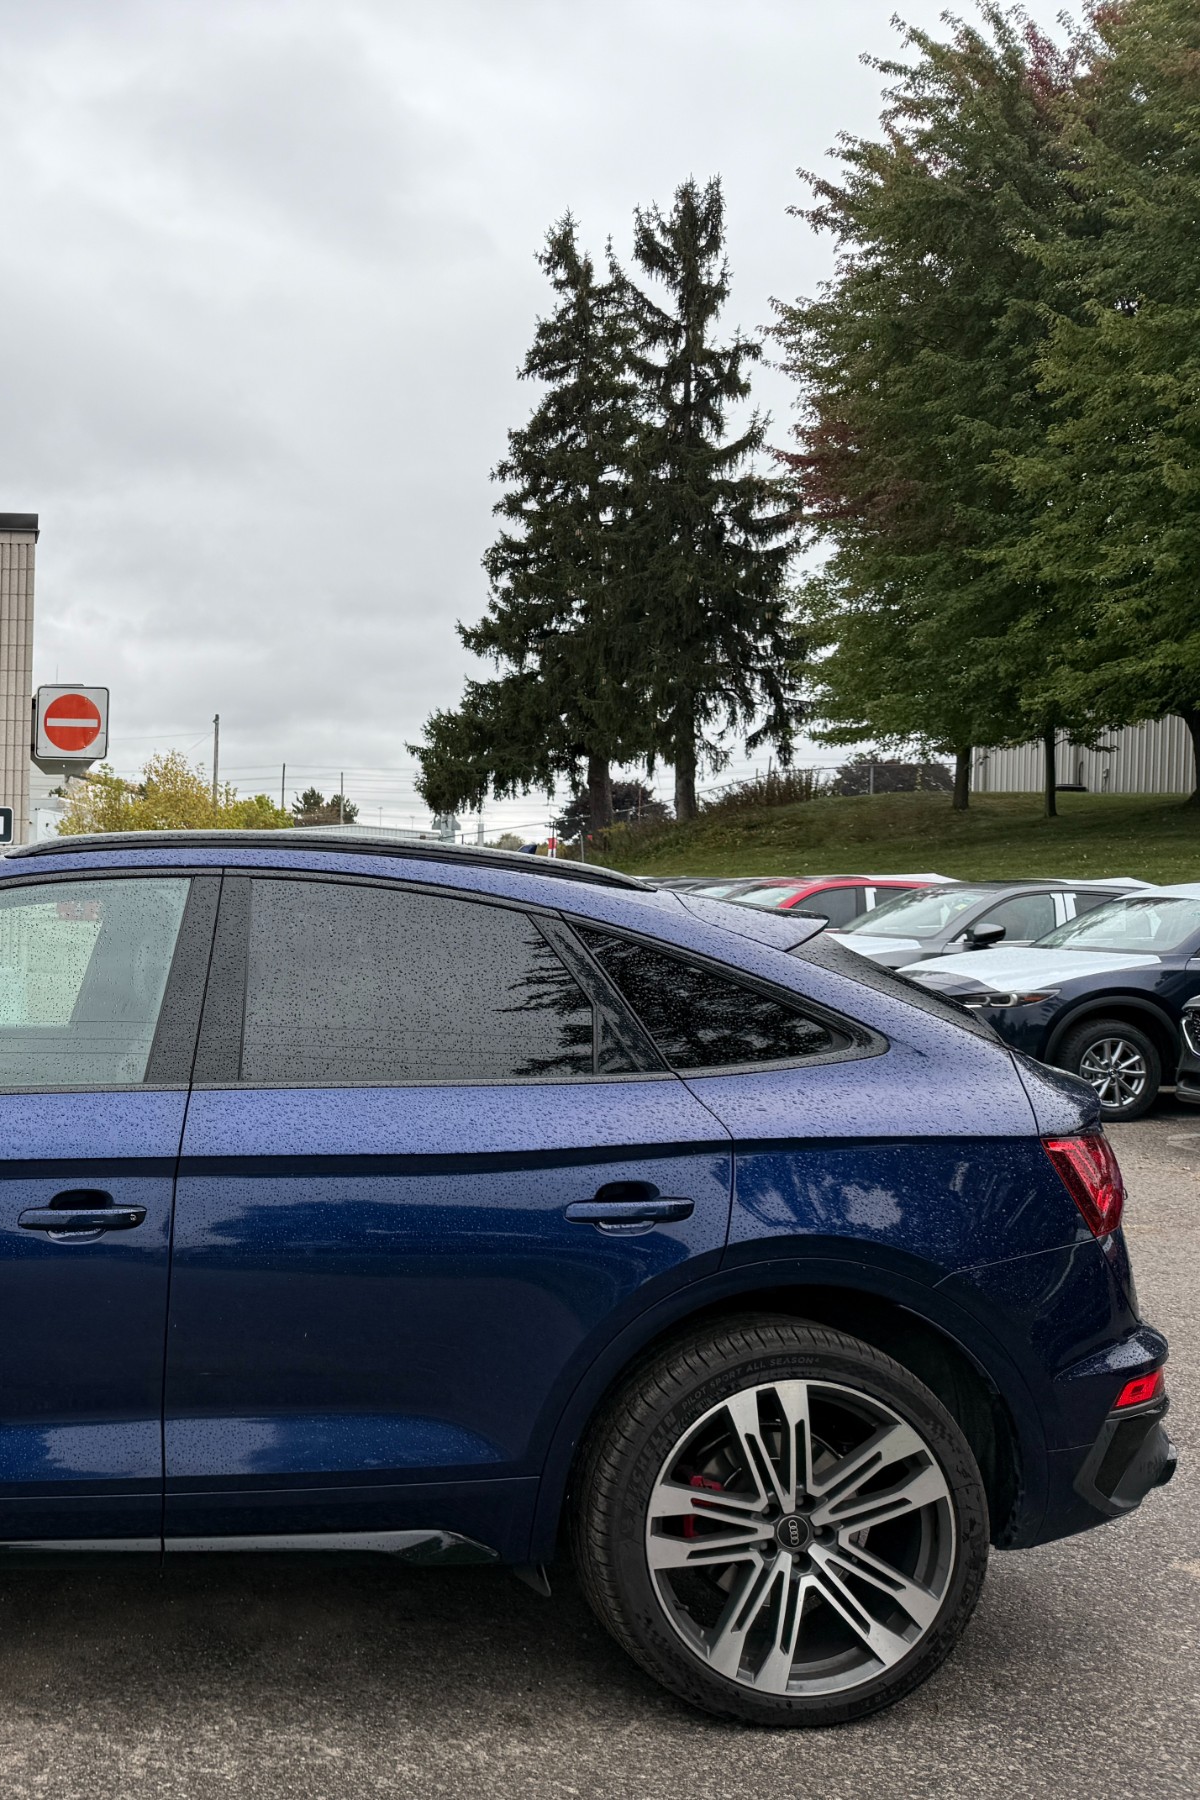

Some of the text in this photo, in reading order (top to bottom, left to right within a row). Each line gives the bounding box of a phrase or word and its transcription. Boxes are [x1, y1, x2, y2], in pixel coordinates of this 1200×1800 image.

[680, 1386, 707, 1410] PILOT
[710, 1367, 743, 1388] SPORT
[745, 1359, 766, 1372] ALL
